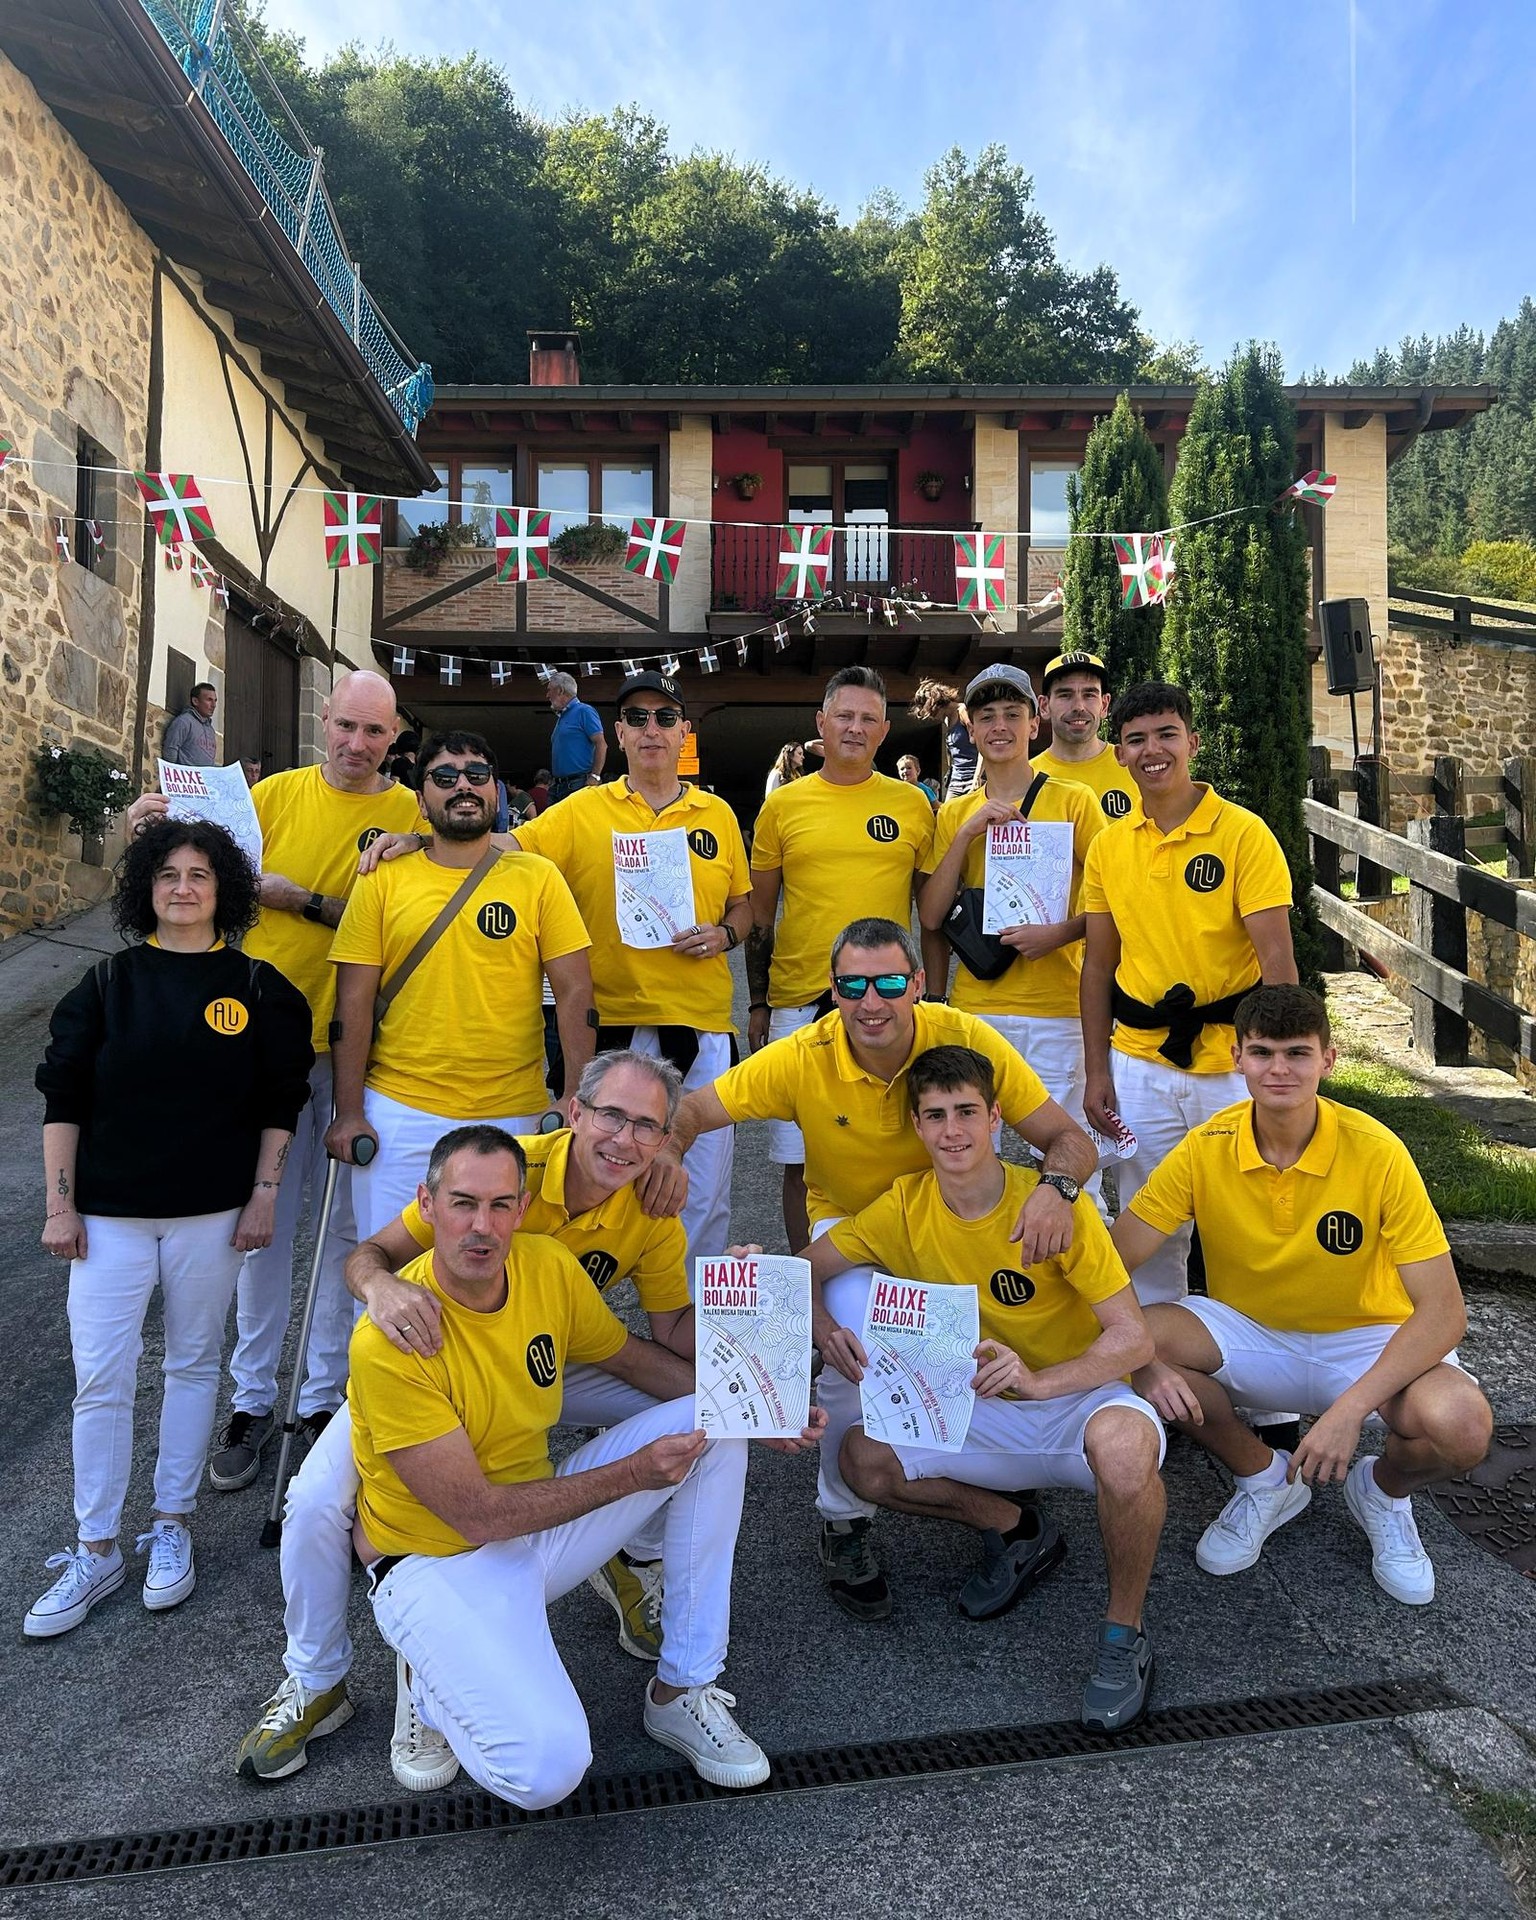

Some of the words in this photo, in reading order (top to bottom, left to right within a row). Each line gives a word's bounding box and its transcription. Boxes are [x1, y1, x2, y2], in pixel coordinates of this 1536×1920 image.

[163, 766, 205, 785] HAIXE
[166, 783, 200, 795] BOLADA
[201, 786, 209, 795] II
[992, 826, 1031, 843] HAIXE
[614, 837, 647, 856] HAIXE
[991, 843, 1023, 855] BOLADA
[1025, 843, 1031, 855] II
[614, 855, 641, 868] BOLADA
[642, 856, 649, 867] II
[1105, 1110, 1137, 1148] HAIXE
[704, 1262, 758, 1288] HAIXE
[703, 1289, 747, 1308] BOLADA
[750, 1290, 757, 1308] II
[874, 1282, 928, 1312] HAIXE
[872, 1307, 914, 1328] BOLADA
[917, 1313, 925, 1329] II
